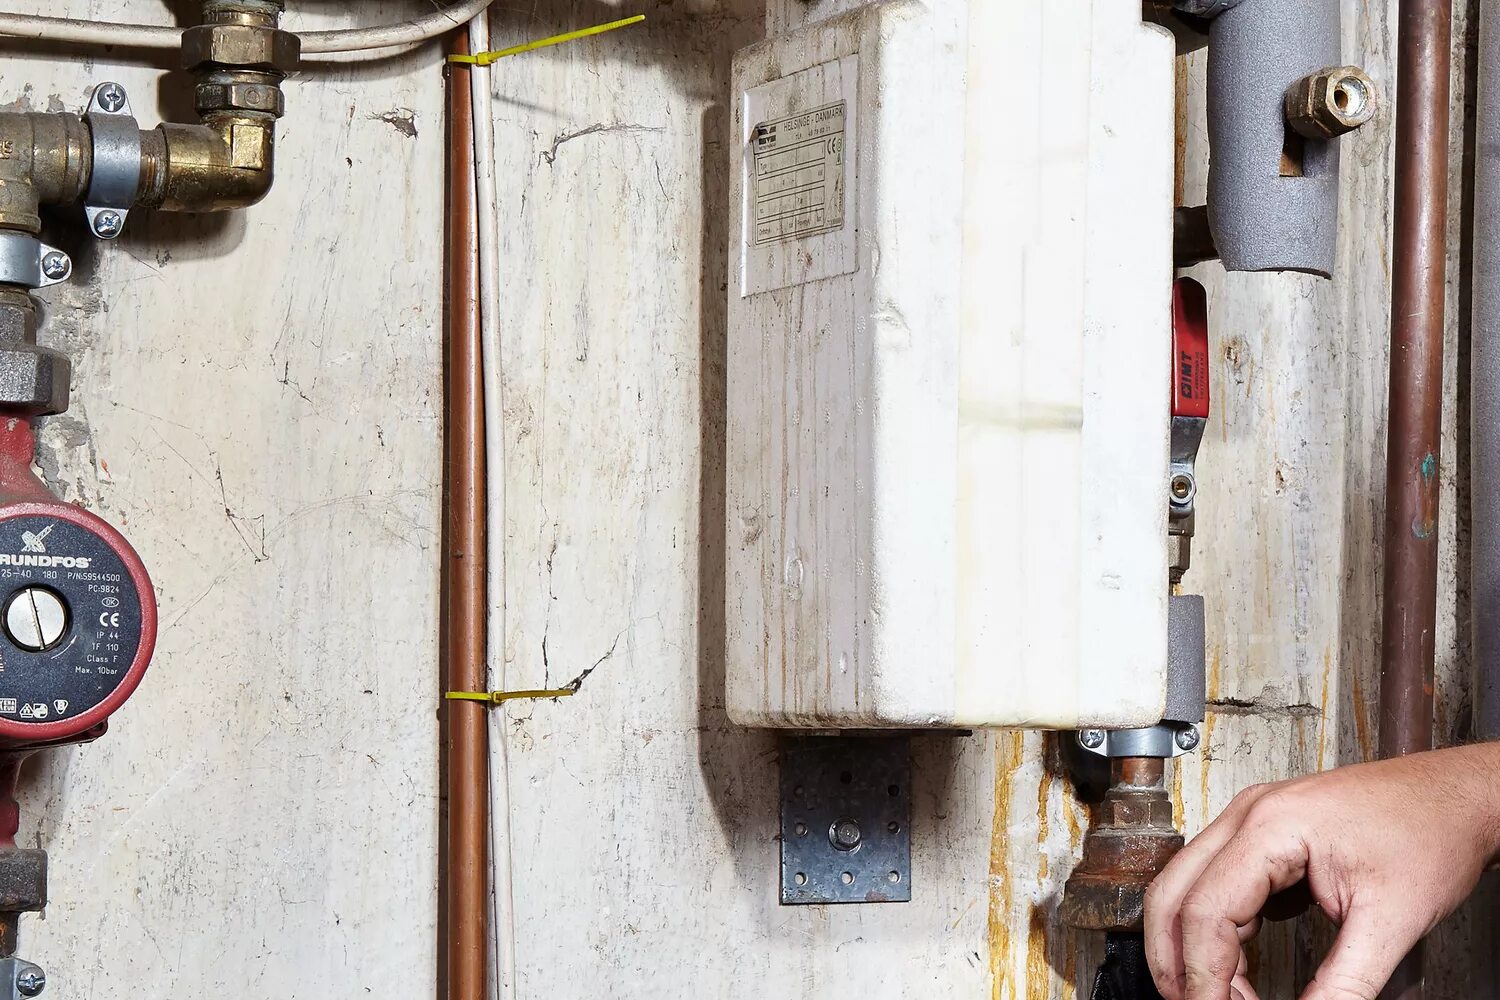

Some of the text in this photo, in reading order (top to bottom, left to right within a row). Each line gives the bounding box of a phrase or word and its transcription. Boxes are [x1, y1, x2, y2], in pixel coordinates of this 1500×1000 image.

[783, 115, 810, 131] HELSINGE
[815, 106, 843, 123] DANMARK
[1181, 350, 1192, 382] IMT
[42, 570, 57, 579] 180
[100, 612, 119, 627] CE
[96, 631, 119, 640] IP 44
[106, 644, 119, 652] 110
[87, 654, 109, 663] Class
